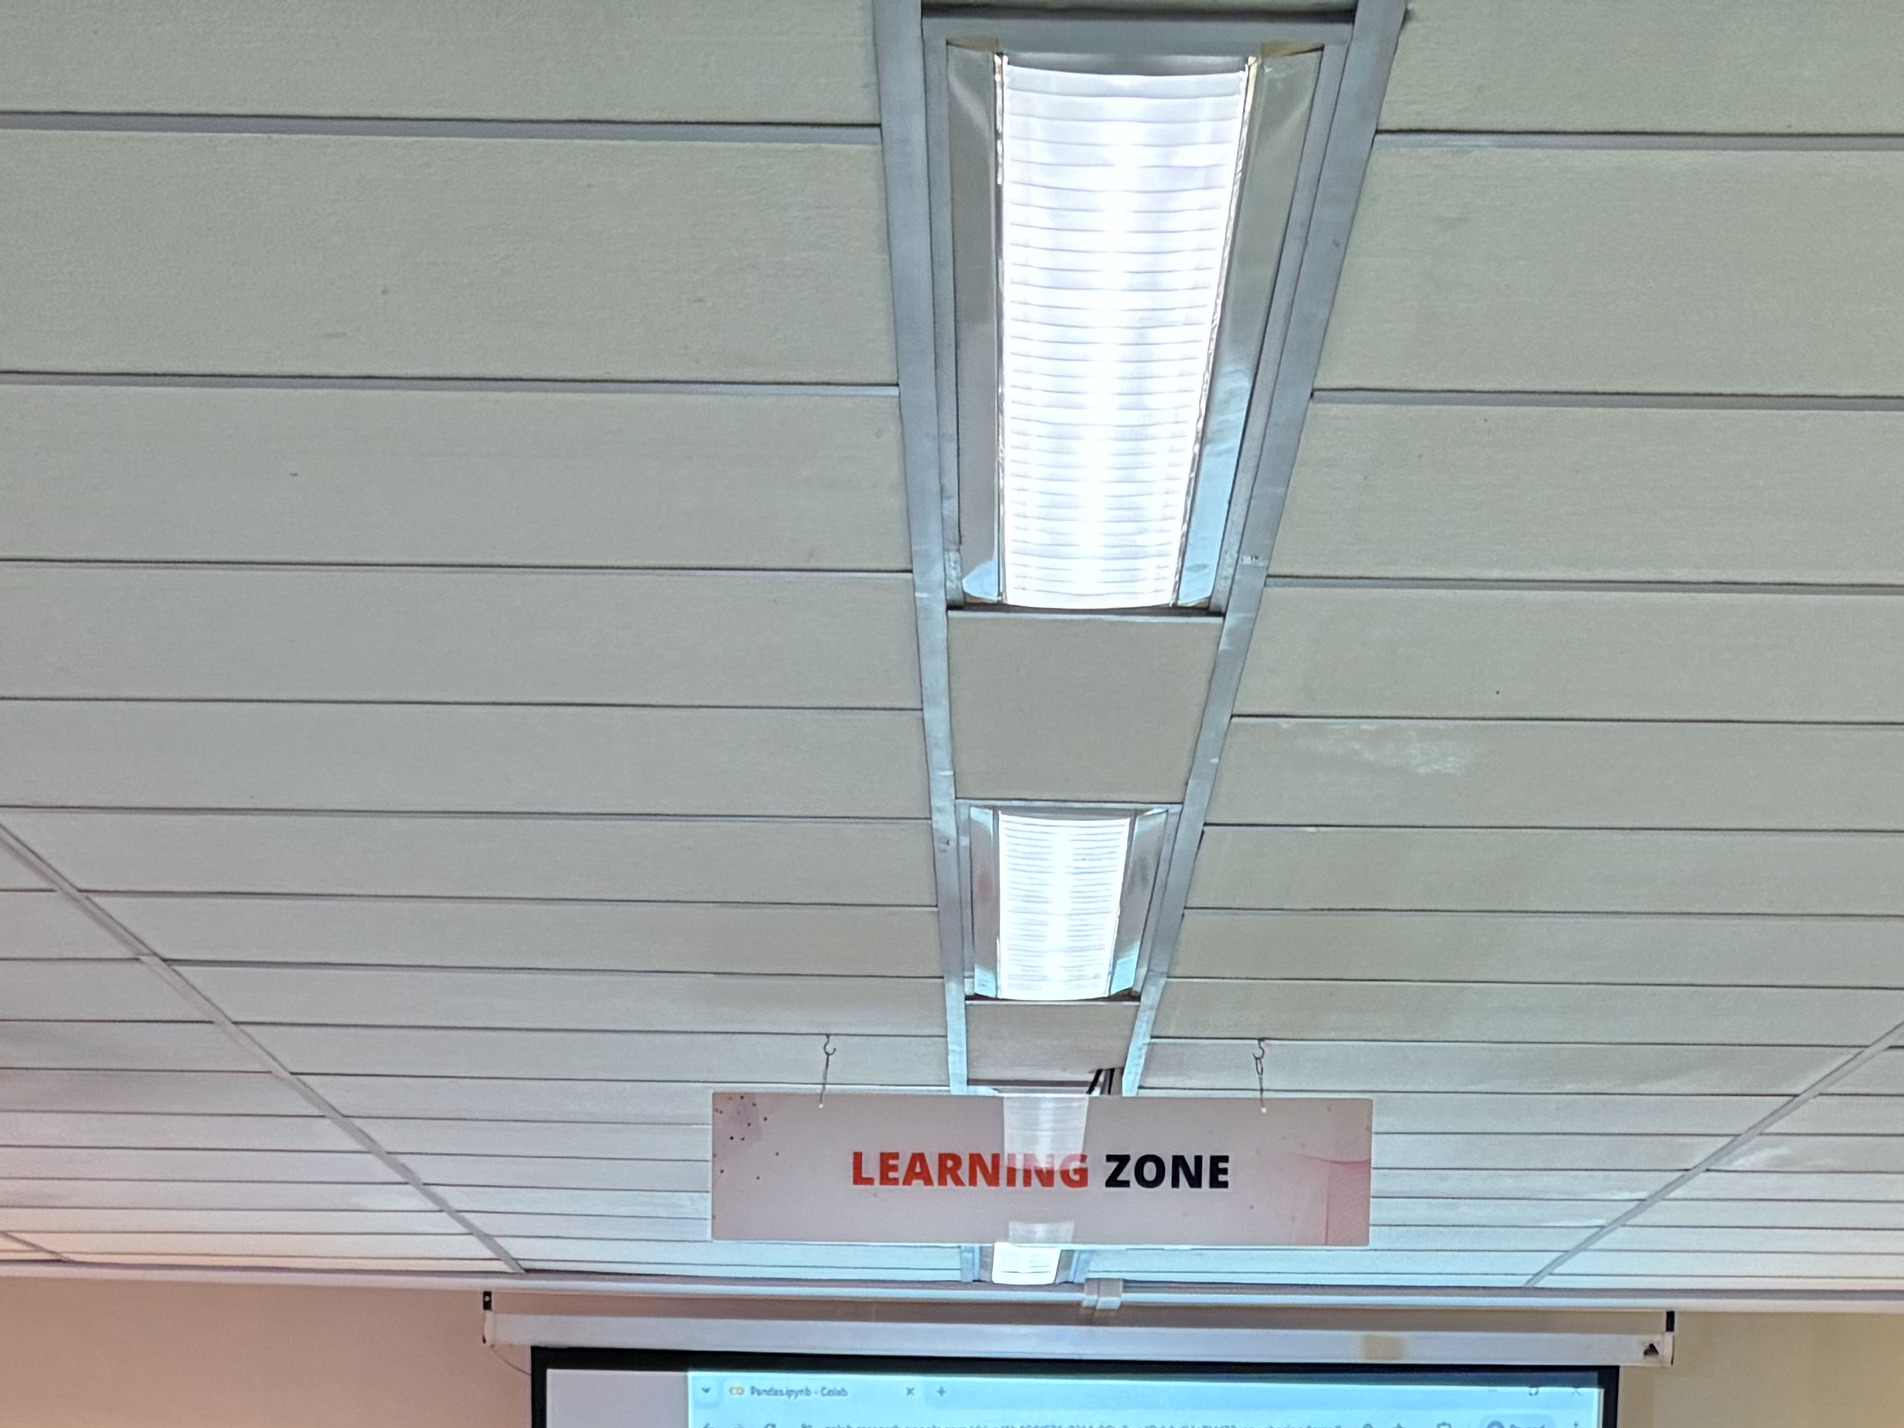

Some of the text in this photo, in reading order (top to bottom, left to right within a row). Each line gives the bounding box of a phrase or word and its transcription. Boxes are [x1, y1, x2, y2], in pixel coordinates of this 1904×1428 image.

[852, 1151, 1229, 1189] LEARNING ZONE
[821, 1387, 848, 1397] Colab
